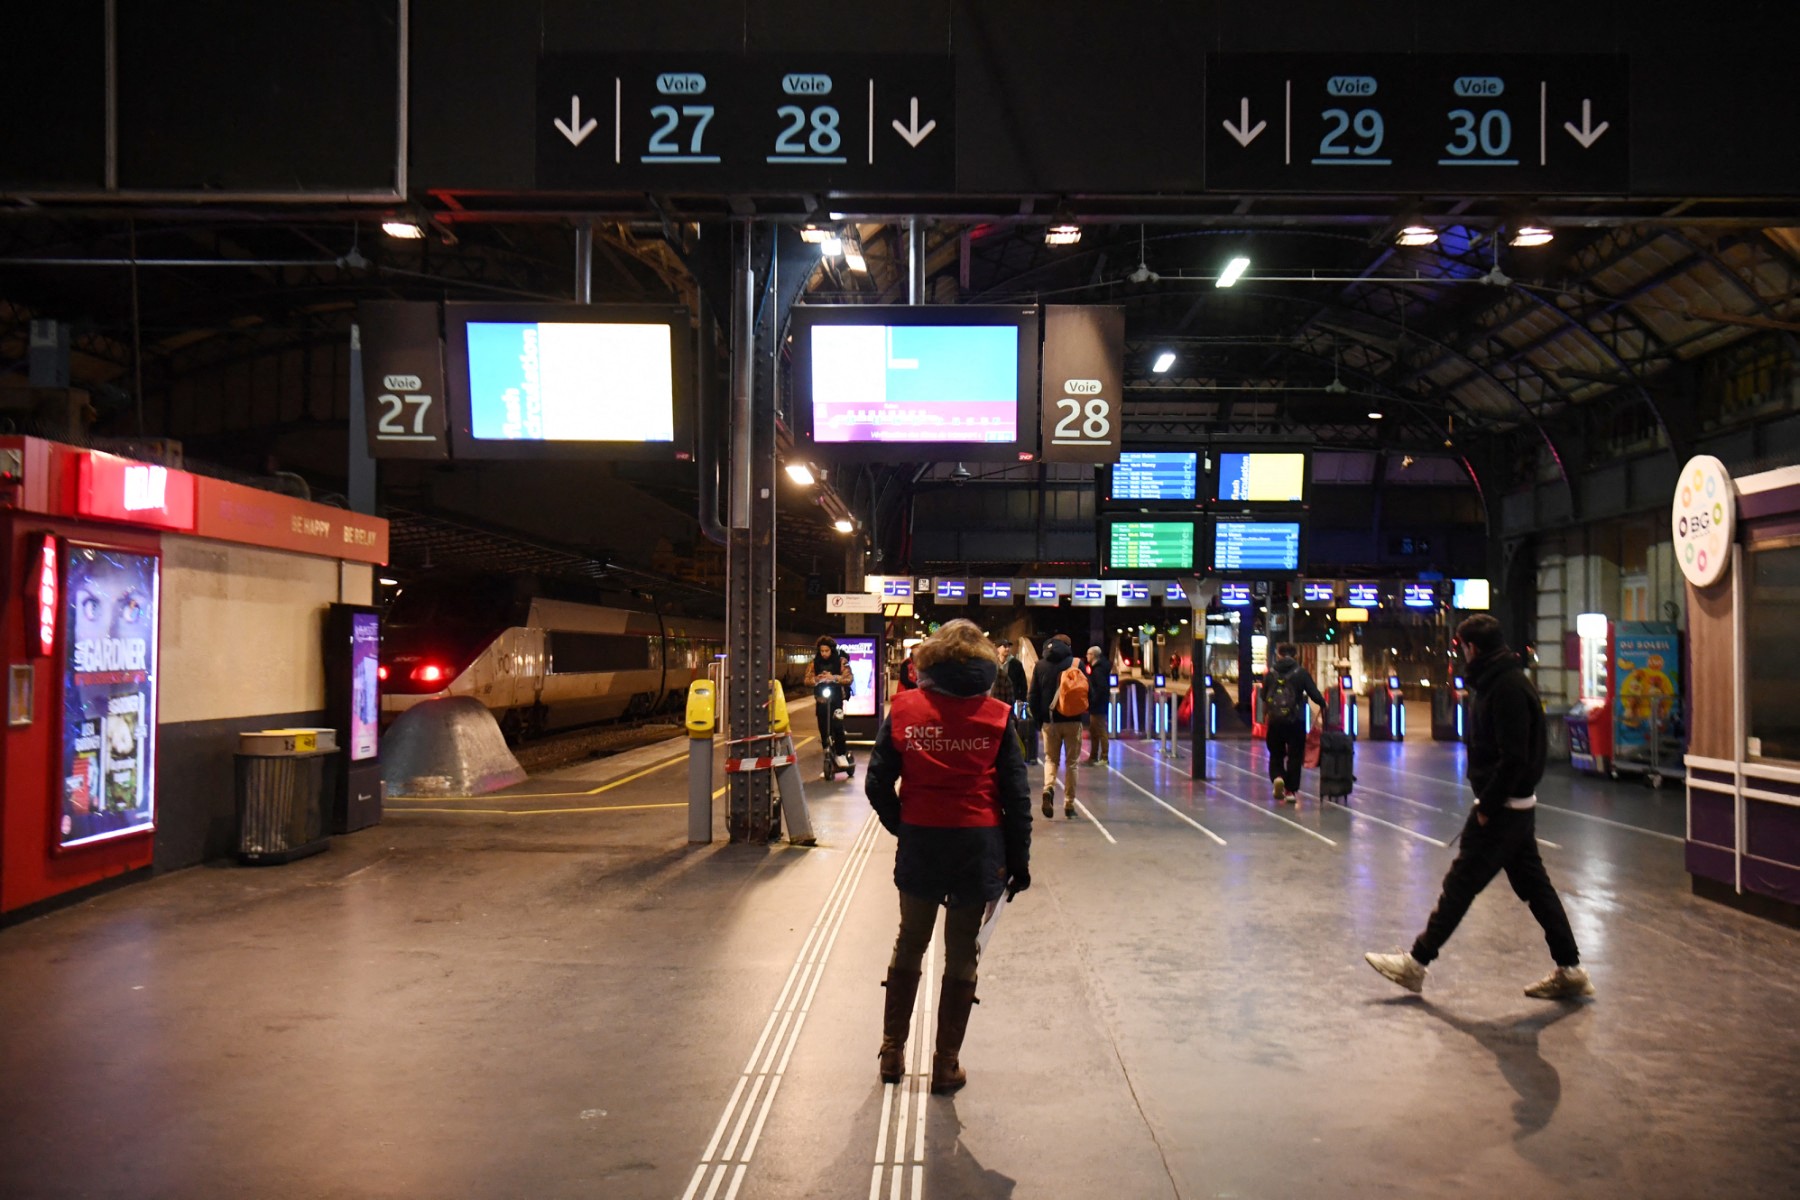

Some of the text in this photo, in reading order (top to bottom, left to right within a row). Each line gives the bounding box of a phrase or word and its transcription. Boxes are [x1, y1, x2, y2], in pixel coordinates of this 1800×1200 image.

[662, 75, 700, 91] Voie
[788, 76, 825, 91] Voie
[1333, 79, 1370, 94] Voie
[1460, 80, 1497, 94] Voie
[649, 105, 715, 153] 27
[775, 105, 841, 154] 28
[1319, 108, 1385, 156] 29
[1445, 109, 1512, 156] 30
[388, 377, 417, 389] Voie
[1069, 381, 1097, 392] Voie
[378, 394, 432, 434] 27
[1054, 398, 1110, 438] 28
[304, 518, 330, 538] HAPPY
[1690, 511, 1710, 533] BG
[344, 525, 354, 544] BE
[40, 547, 56, 645] TABAC
[86, 638, 147, 673] GARDNER
[904, 726, 943, 739] SNCF
[905, 736, 991, 752] ASSISTANCE
